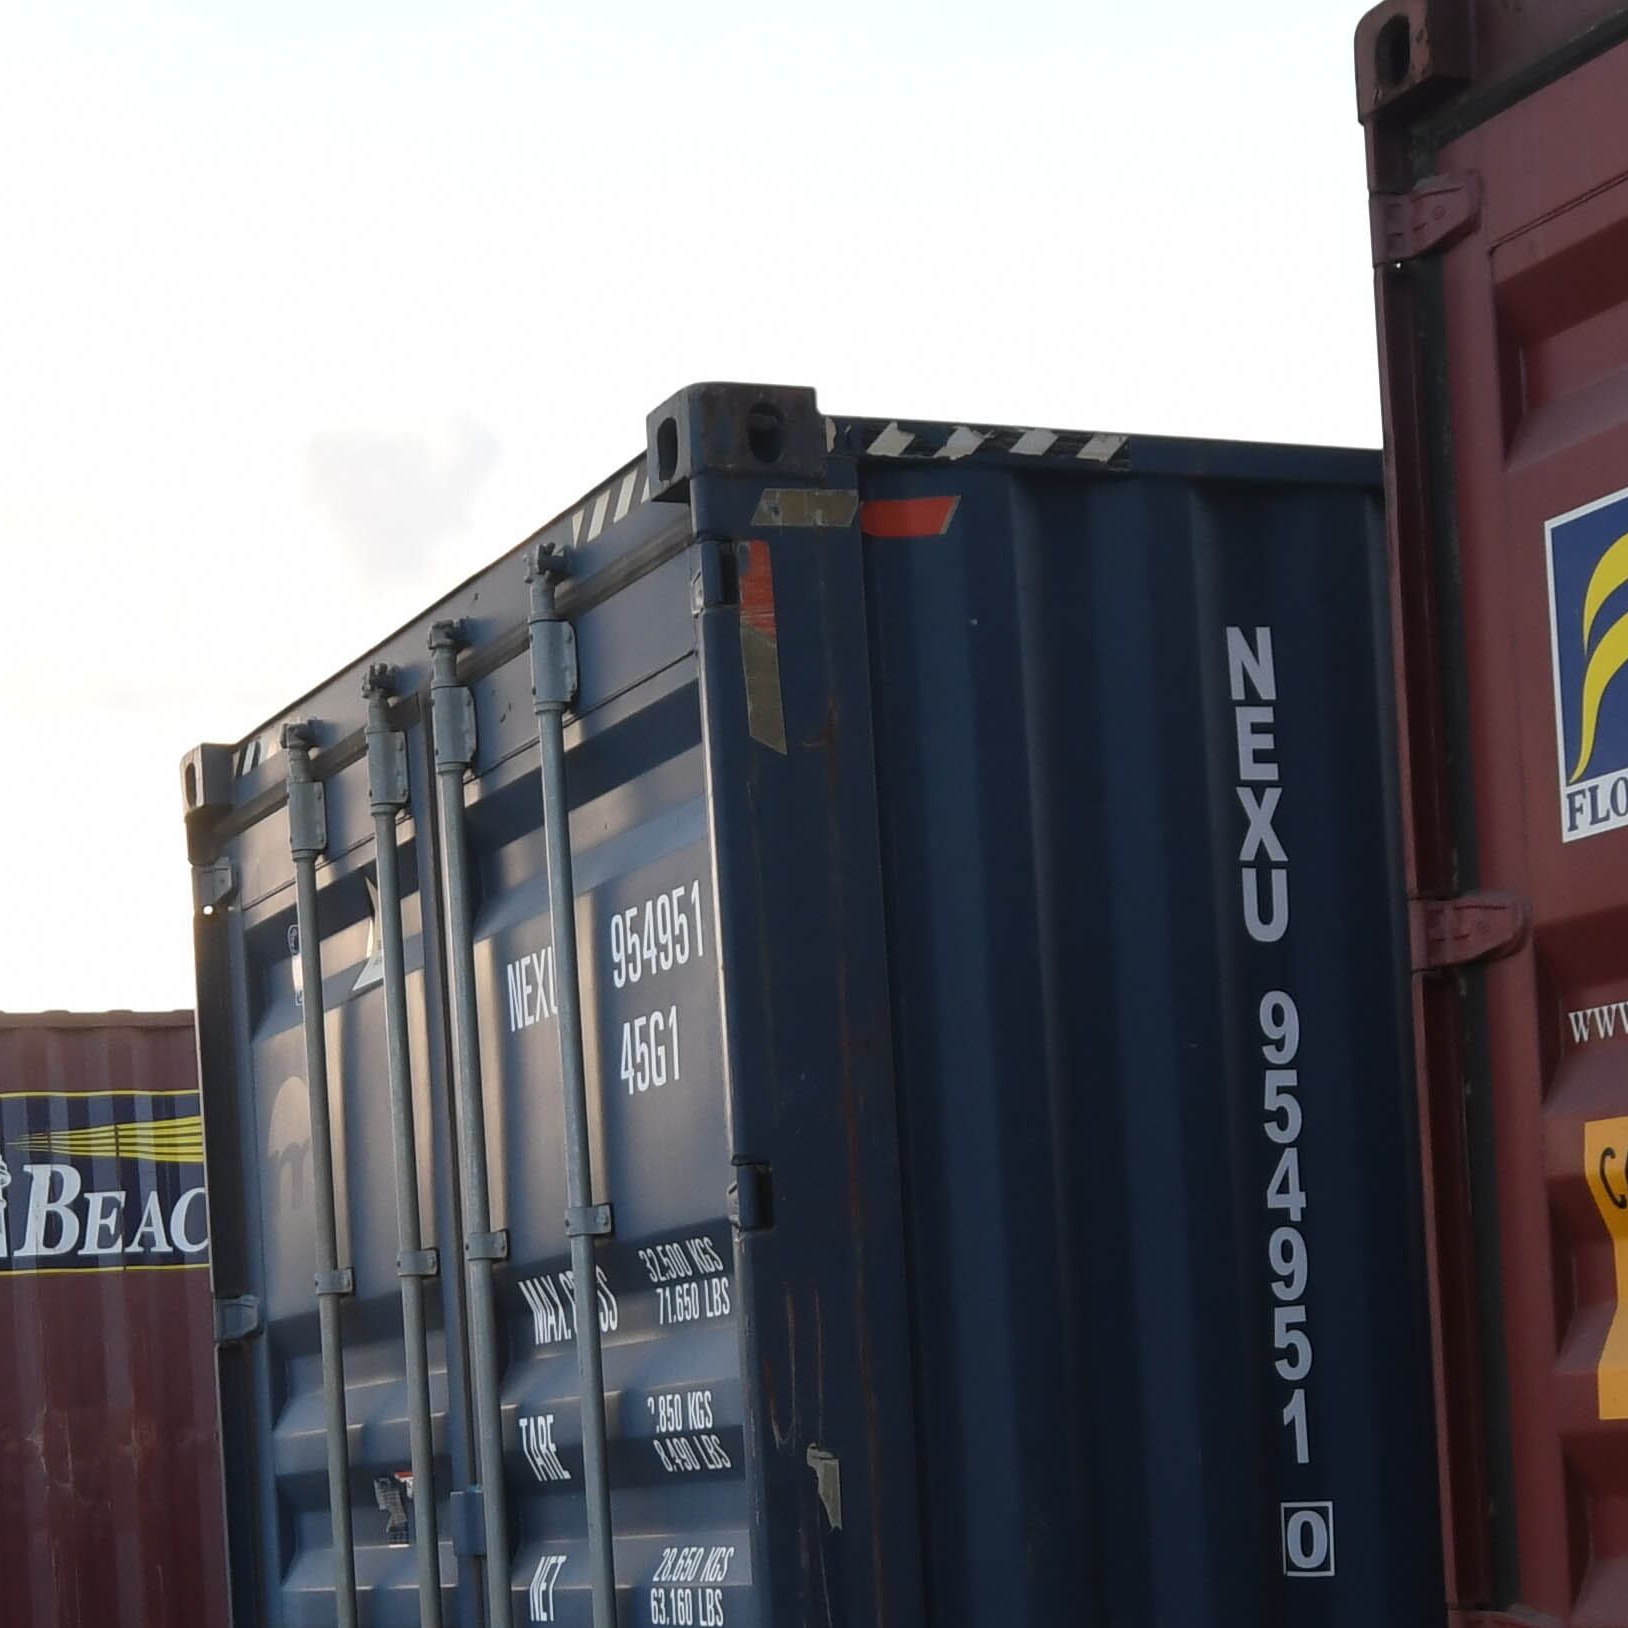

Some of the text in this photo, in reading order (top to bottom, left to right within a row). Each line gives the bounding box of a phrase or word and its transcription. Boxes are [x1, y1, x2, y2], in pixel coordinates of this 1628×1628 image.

[1225, 626, 1290, 943] NEXU
[506, 879, 704, 1032] NEXU 954951
[620, 1004, 681, 1095] 45G1
[685, 1237, 724, 1273] KGS
[1258, 990, 1331, 1572] 954951 0
[655, 1277, 731, 1325] 71.650 LBS
[687, 1390, 714, 1431] KGS
[519, 1413, 572, 1482] TARE
[694, 1434, 732, 1470] LBS
[529, 1555, 567, 1622] NET
[699, 1546, 735, 1582] KGS
[650, 1588, 724, 1627] 63.160 LBS
